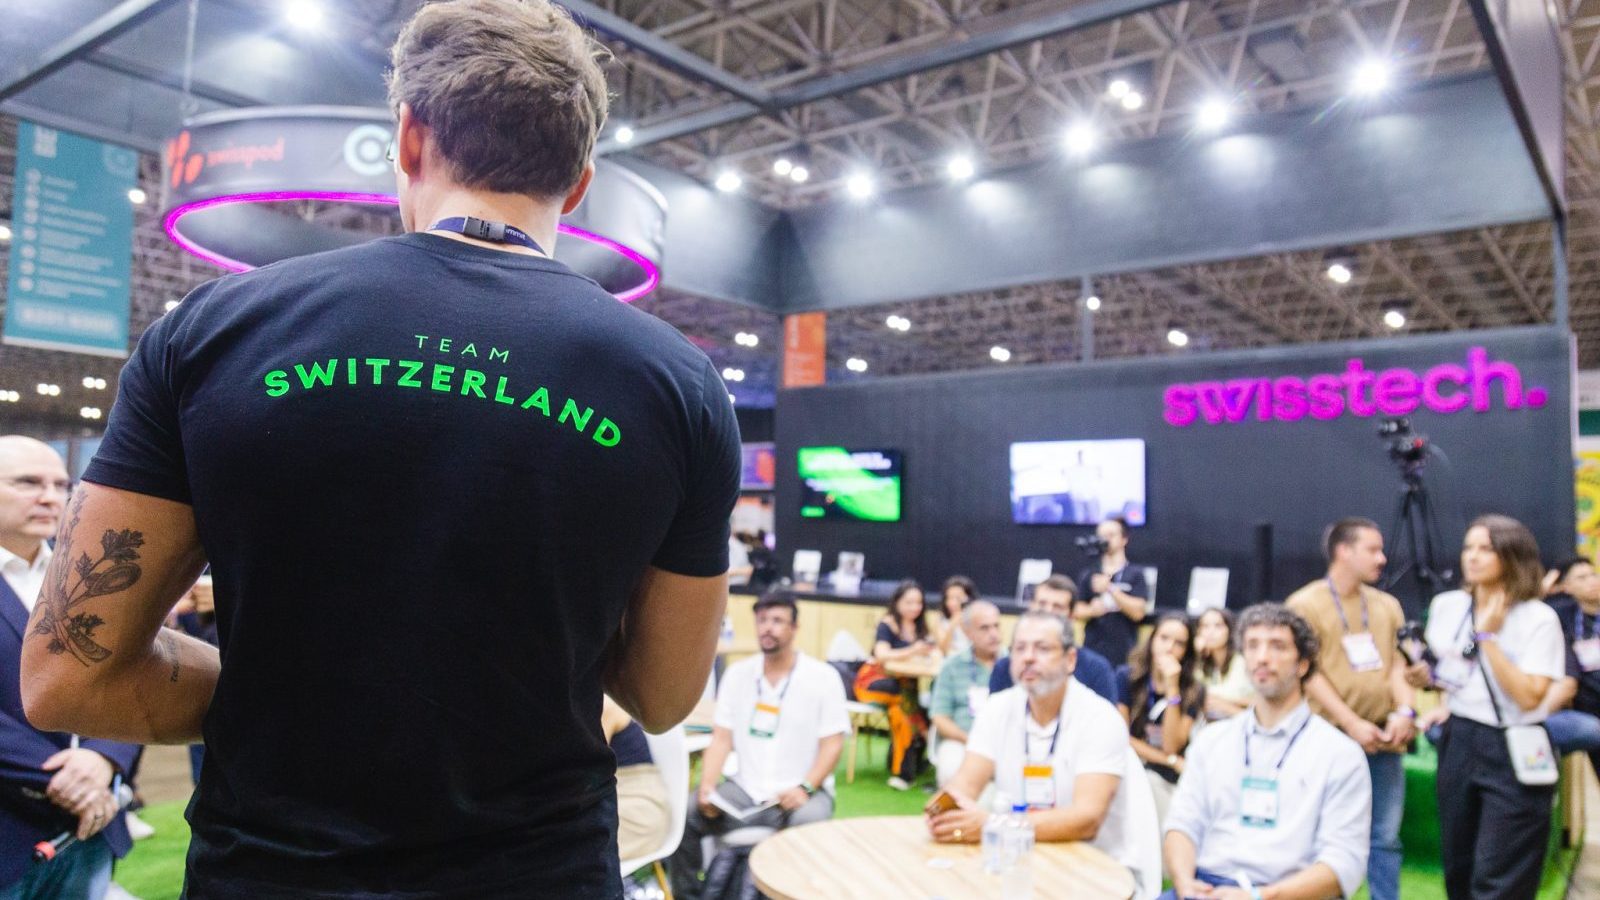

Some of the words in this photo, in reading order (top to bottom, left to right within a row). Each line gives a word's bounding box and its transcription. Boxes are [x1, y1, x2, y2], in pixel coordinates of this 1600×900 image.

[415, 334, 510, 363] TEAM
[1162, 345, 1549, 428] swisstech.
[264, 357, 622, 447] SWITZERLAND
